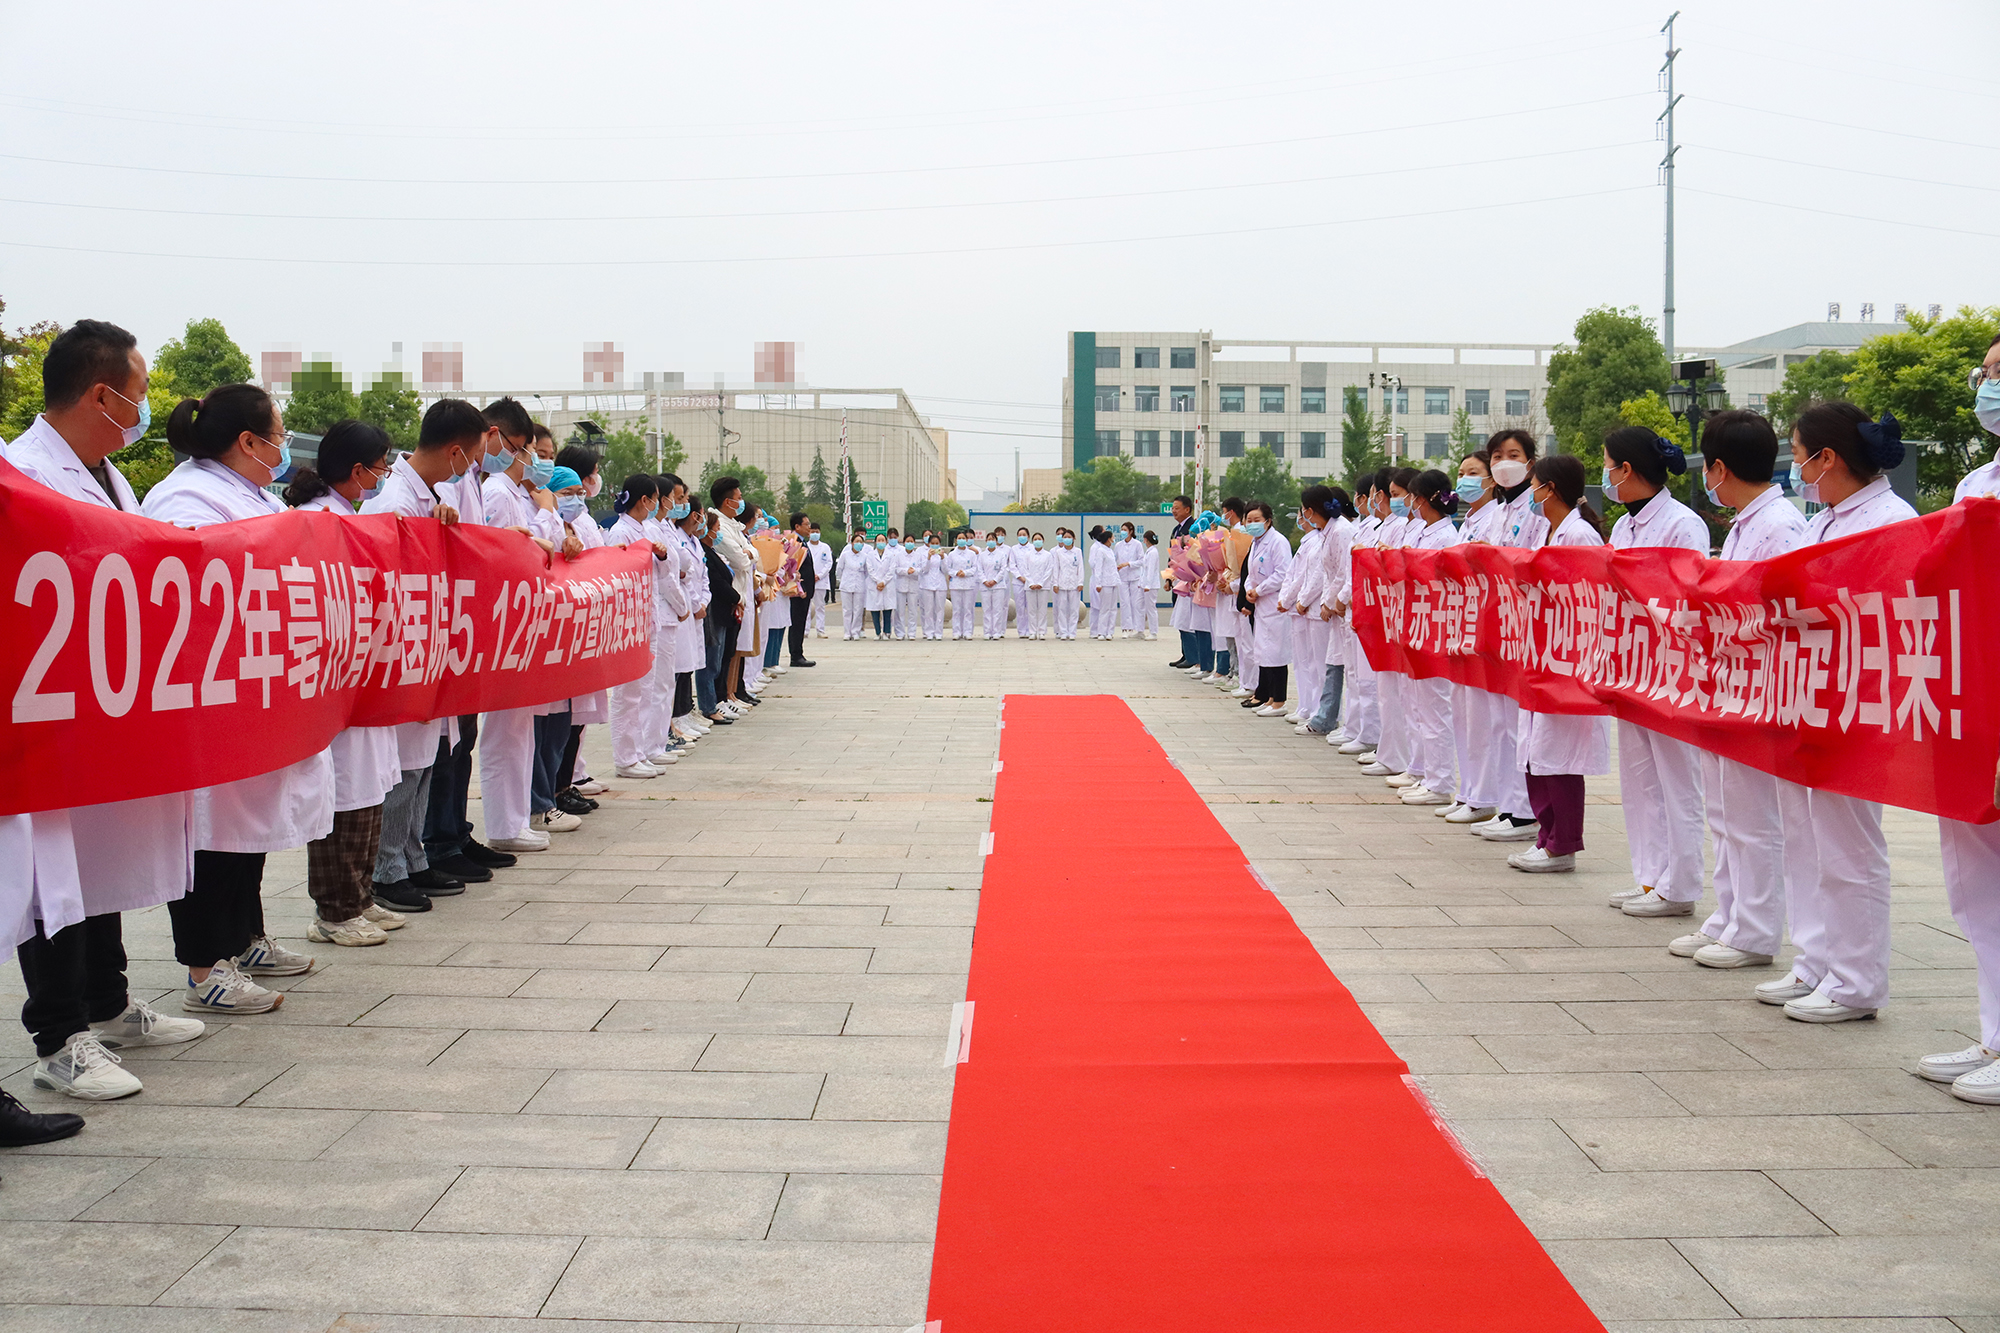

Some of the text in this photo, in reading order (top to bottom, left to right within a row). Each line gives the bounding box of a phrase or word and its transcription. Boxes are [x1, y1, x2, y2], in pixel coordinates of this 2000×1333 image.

[864, 504, 885, 516] 入口
[1493, 573, 1962, 742] 热欢迎我院抗疫英雄凯旋归来!
